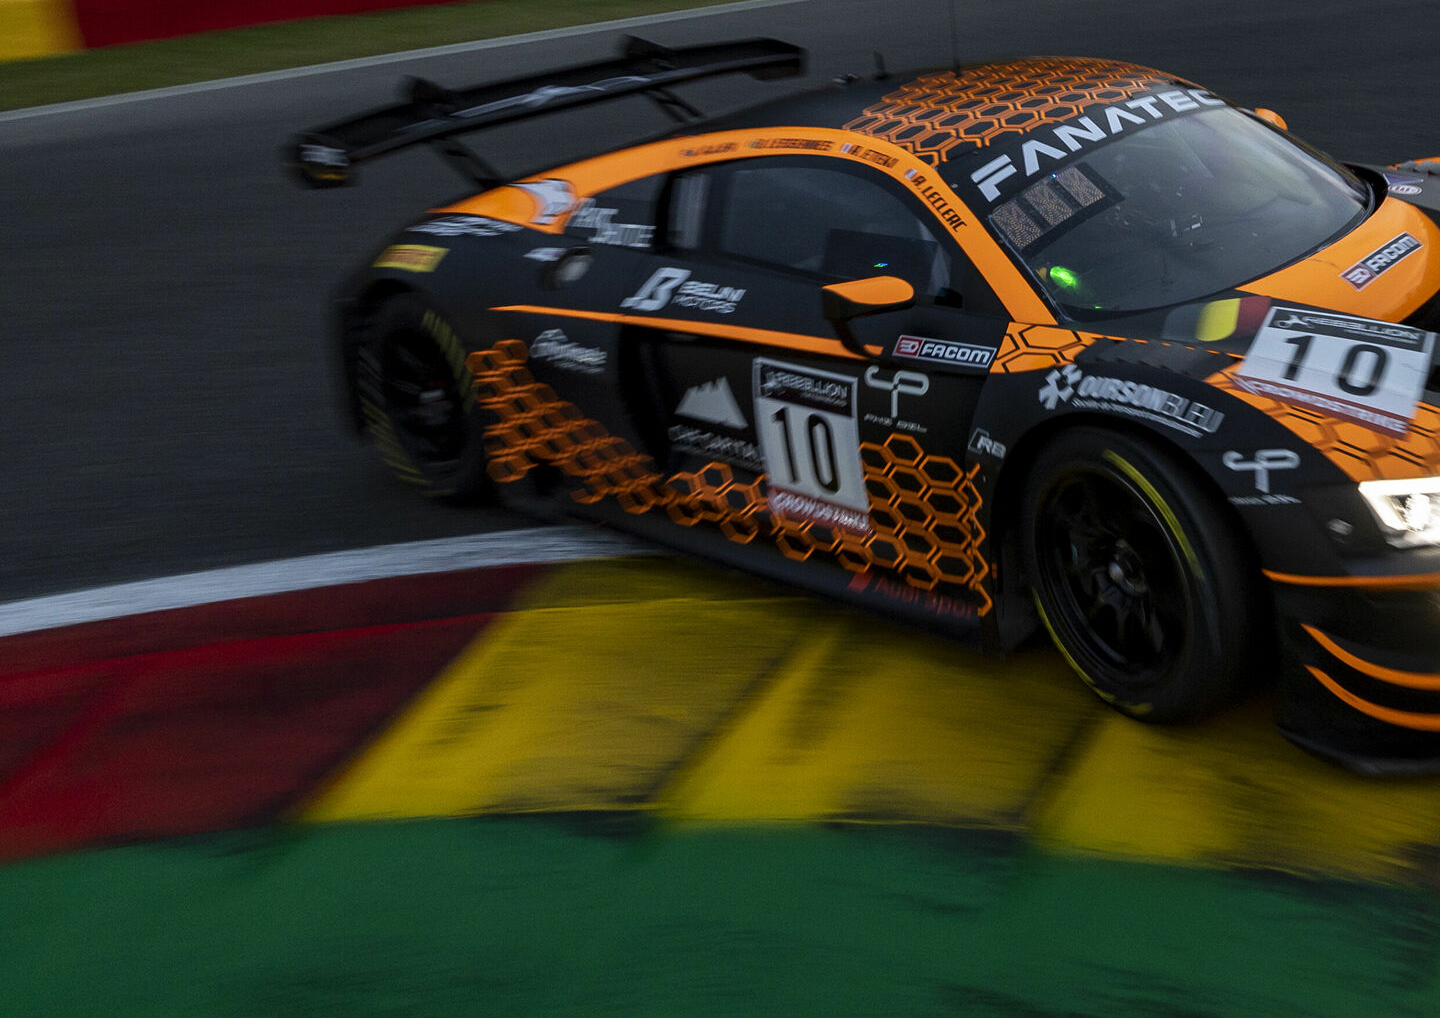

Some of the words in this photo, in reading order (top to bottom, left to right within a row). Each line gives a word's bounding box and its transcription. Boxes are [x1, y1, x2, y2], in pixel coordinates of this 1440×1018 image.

[970, 89, 1226, 202] FANATEC
[921, 186, 967, 232] LECLERC
[1365, 235, 1420, 272] FACOM
[921, 342, 991, 364] FACOM
[1284, 335, 1389, 396] 10
[771, 406, 841, 494] 10
